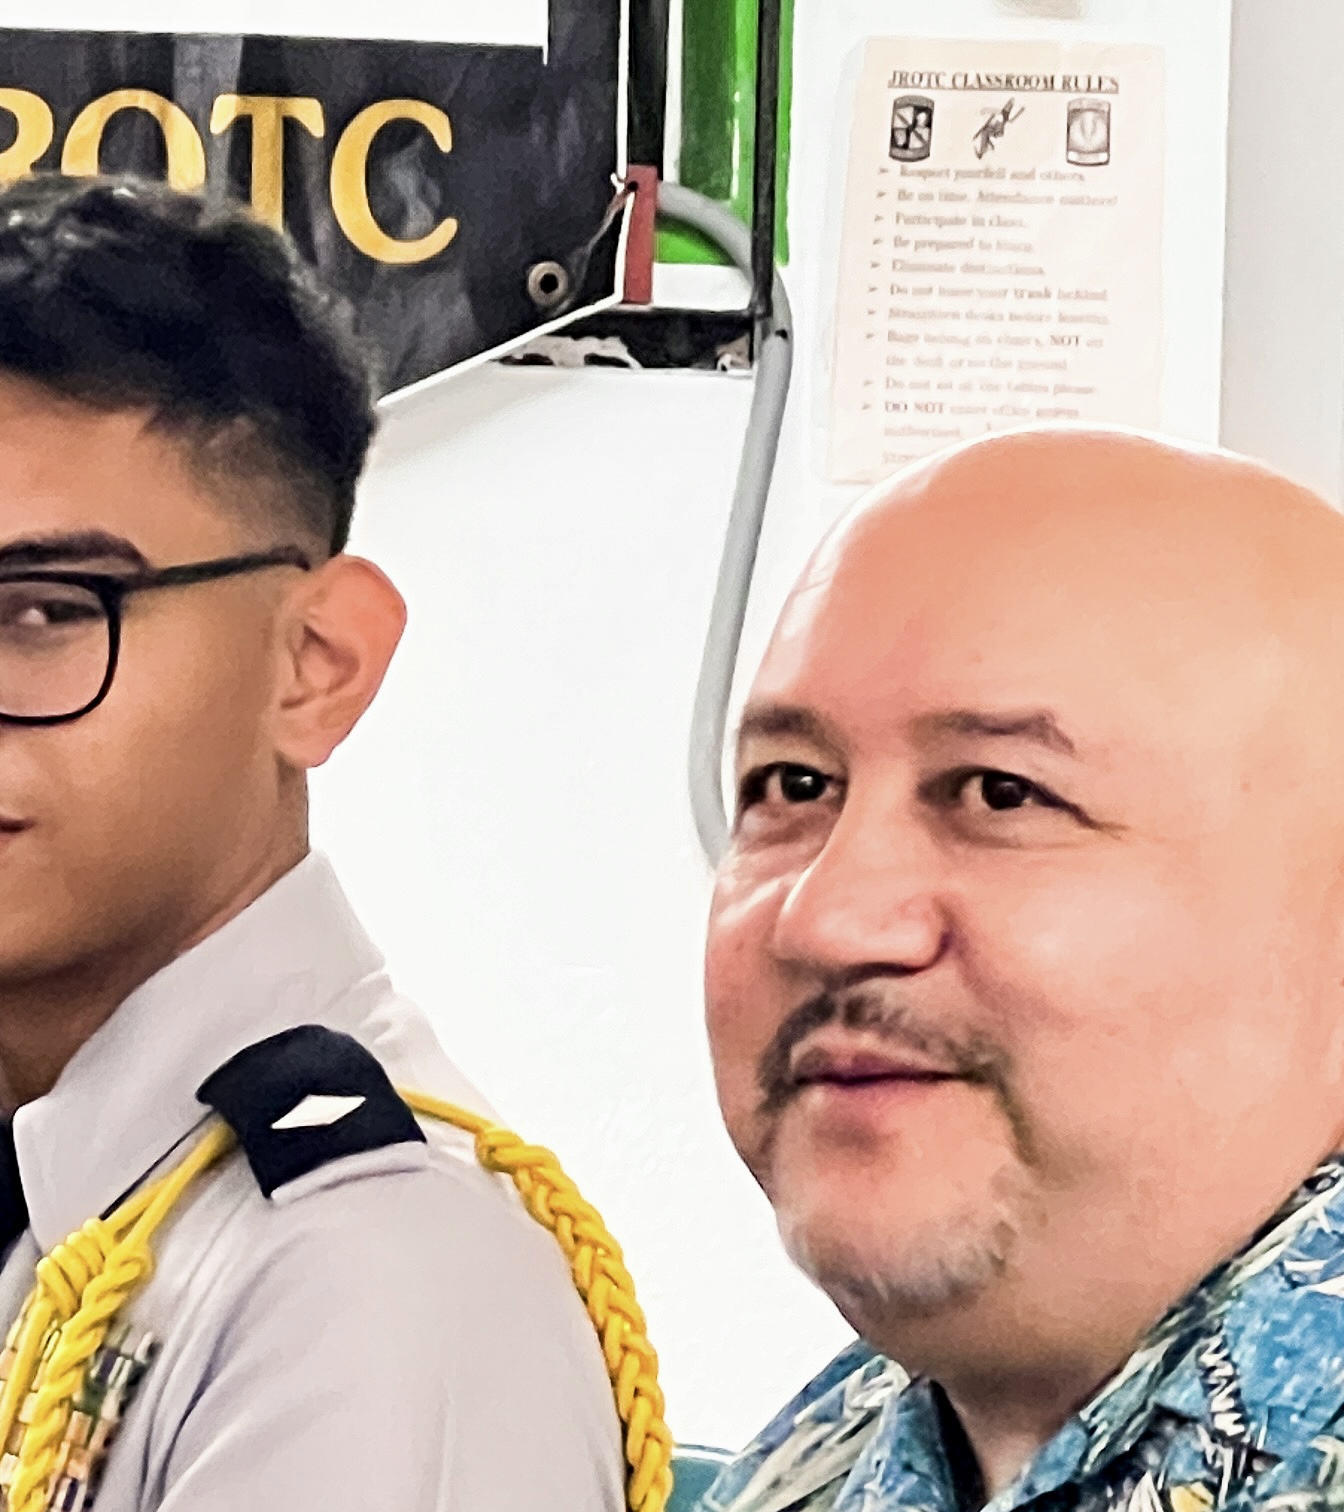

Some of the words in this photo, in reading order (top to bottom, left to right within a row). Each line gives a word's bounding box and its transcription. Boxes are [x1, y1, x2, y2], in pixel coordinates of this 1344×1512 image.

[891, 70, 947, 88] JROTC
[951, 72, 1054, 91] CLASSROOM
[1061, 74, 1119, 94] RULES
